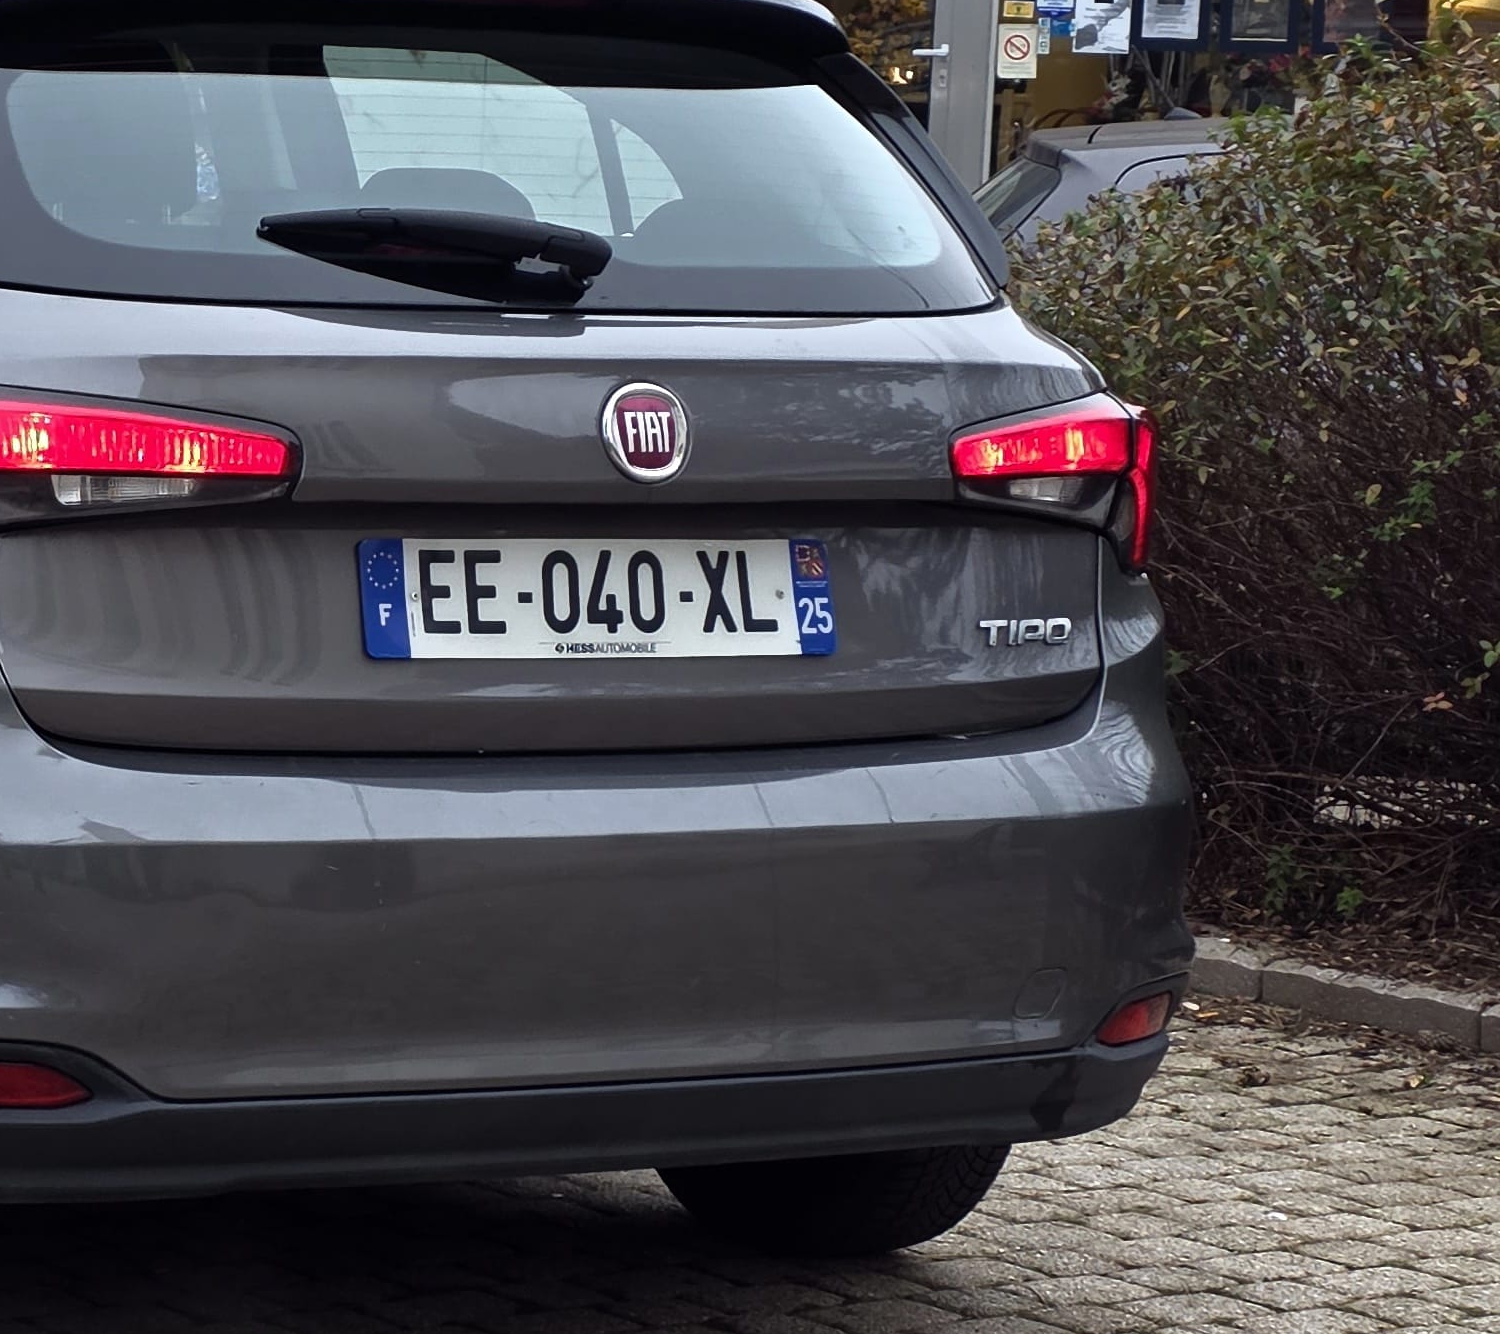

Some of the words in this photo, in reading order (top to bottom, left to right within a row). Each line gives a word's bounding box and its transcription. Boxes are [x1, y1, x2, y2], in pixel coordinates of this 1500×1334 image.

[623, 411, 671, 453] FIAT
[418, 549, 780, 635] EE-040-XL
[378, 603, 393, 627] F
[799, 597, 834, 634] 25
[979, 617, 1072, 647] TIPO
